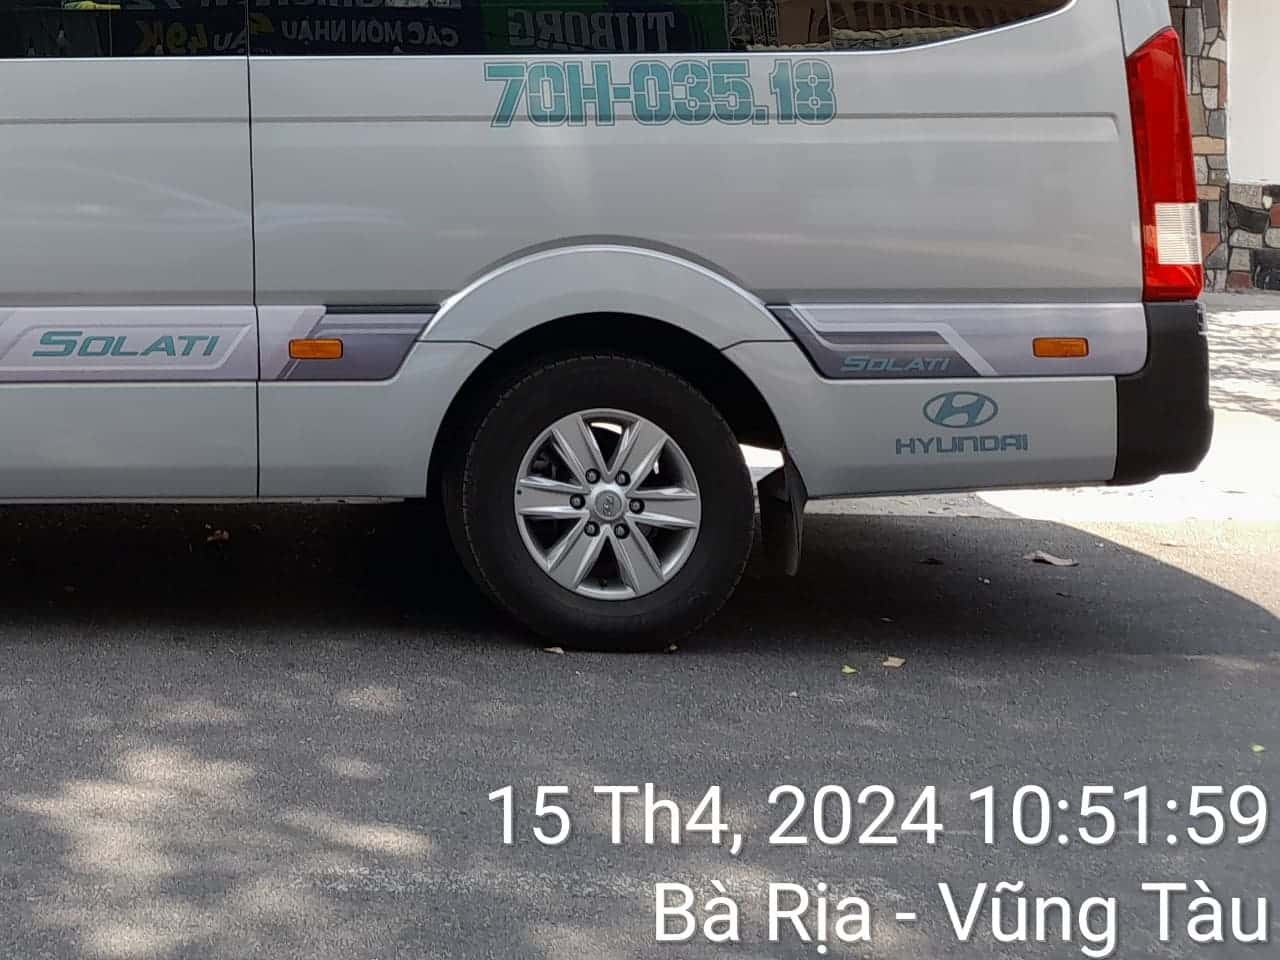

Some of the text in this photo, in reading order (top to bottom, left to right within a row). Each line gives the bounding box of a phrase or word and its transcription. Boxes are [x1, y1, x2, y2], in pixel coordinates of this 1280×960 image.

[484, 58, 836, 128] 70H-035.18
[32, 330, 220, 358] SOLATI
[841, 355, 951, 373] SOLATI
[896, 433, 1029, 456] HYUNDAI
